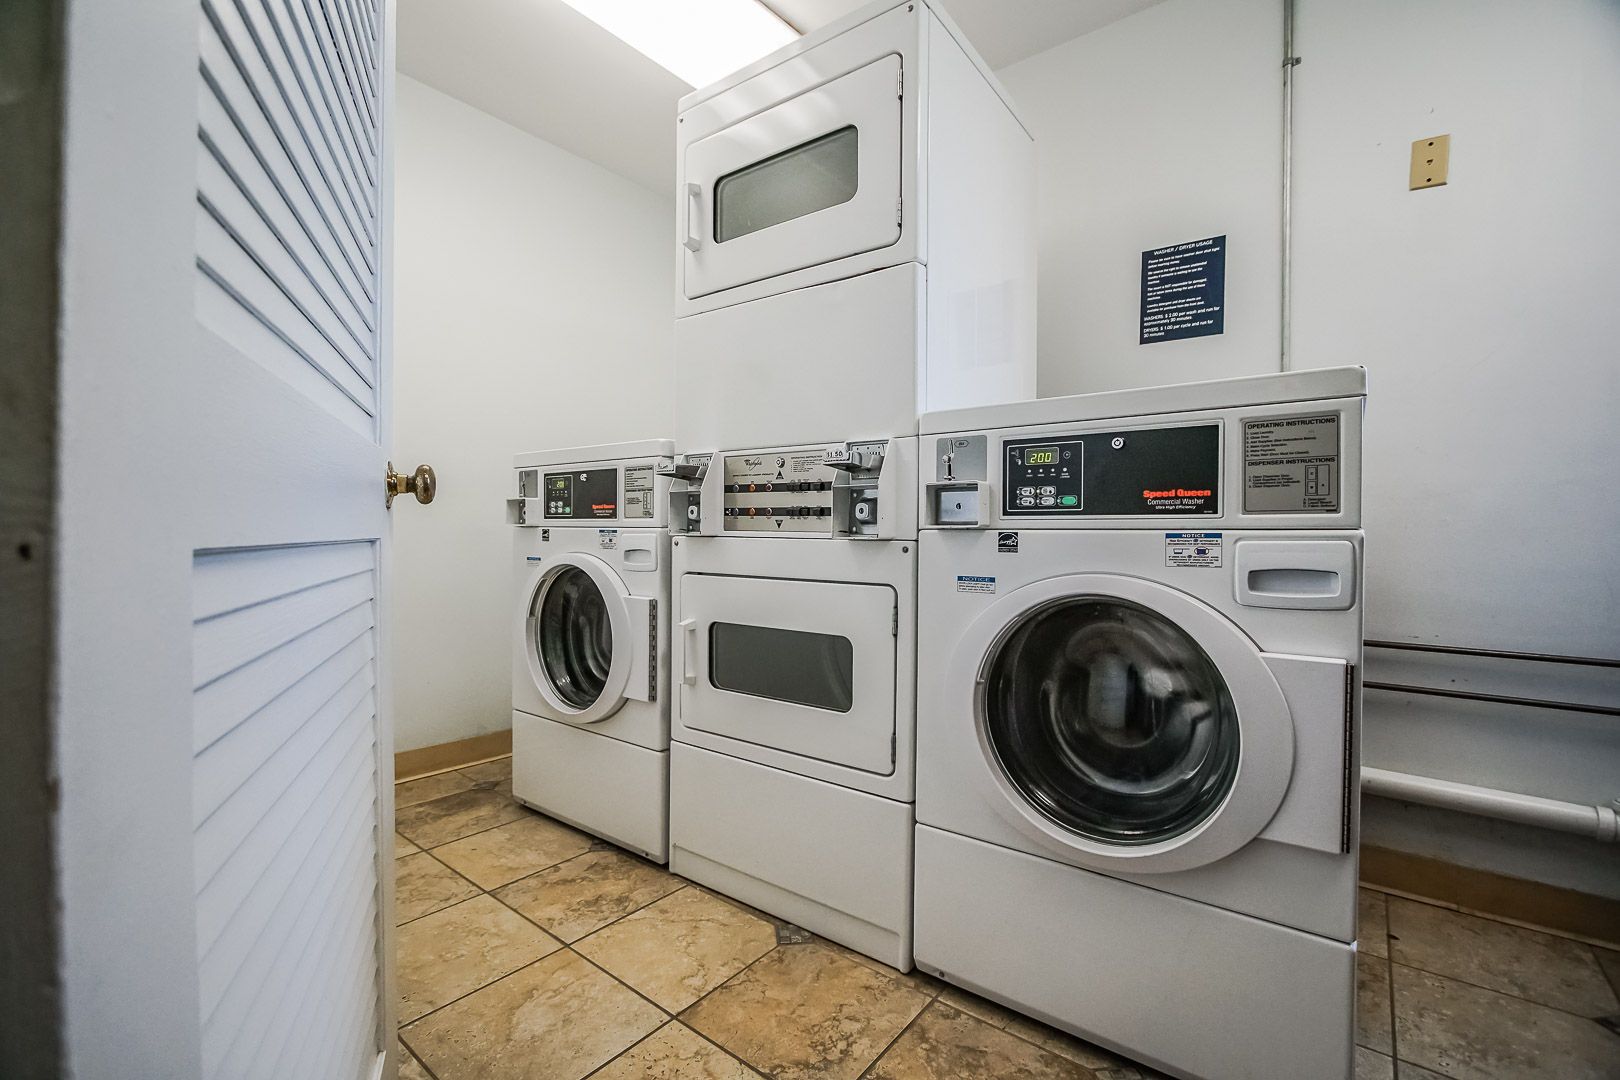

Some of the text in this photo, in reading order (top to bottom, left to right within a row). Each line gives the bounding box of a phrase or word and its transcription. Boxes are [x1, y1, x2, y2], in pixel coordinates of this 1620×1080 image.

[1154, 247, 1174, 255] WASHER
[1179, 243, 1195, 251] DRYER
[1196, 240, 1213, 248] USAGE
[1247, 417, 1336, 430] OPERATING INSTRUCTIONS
[1030, 452, 1052, 463] 200
[1285, 456, 1336, 465] INSTRUCTIONS
[1143, 488, 1211, 498] Speed Queen
